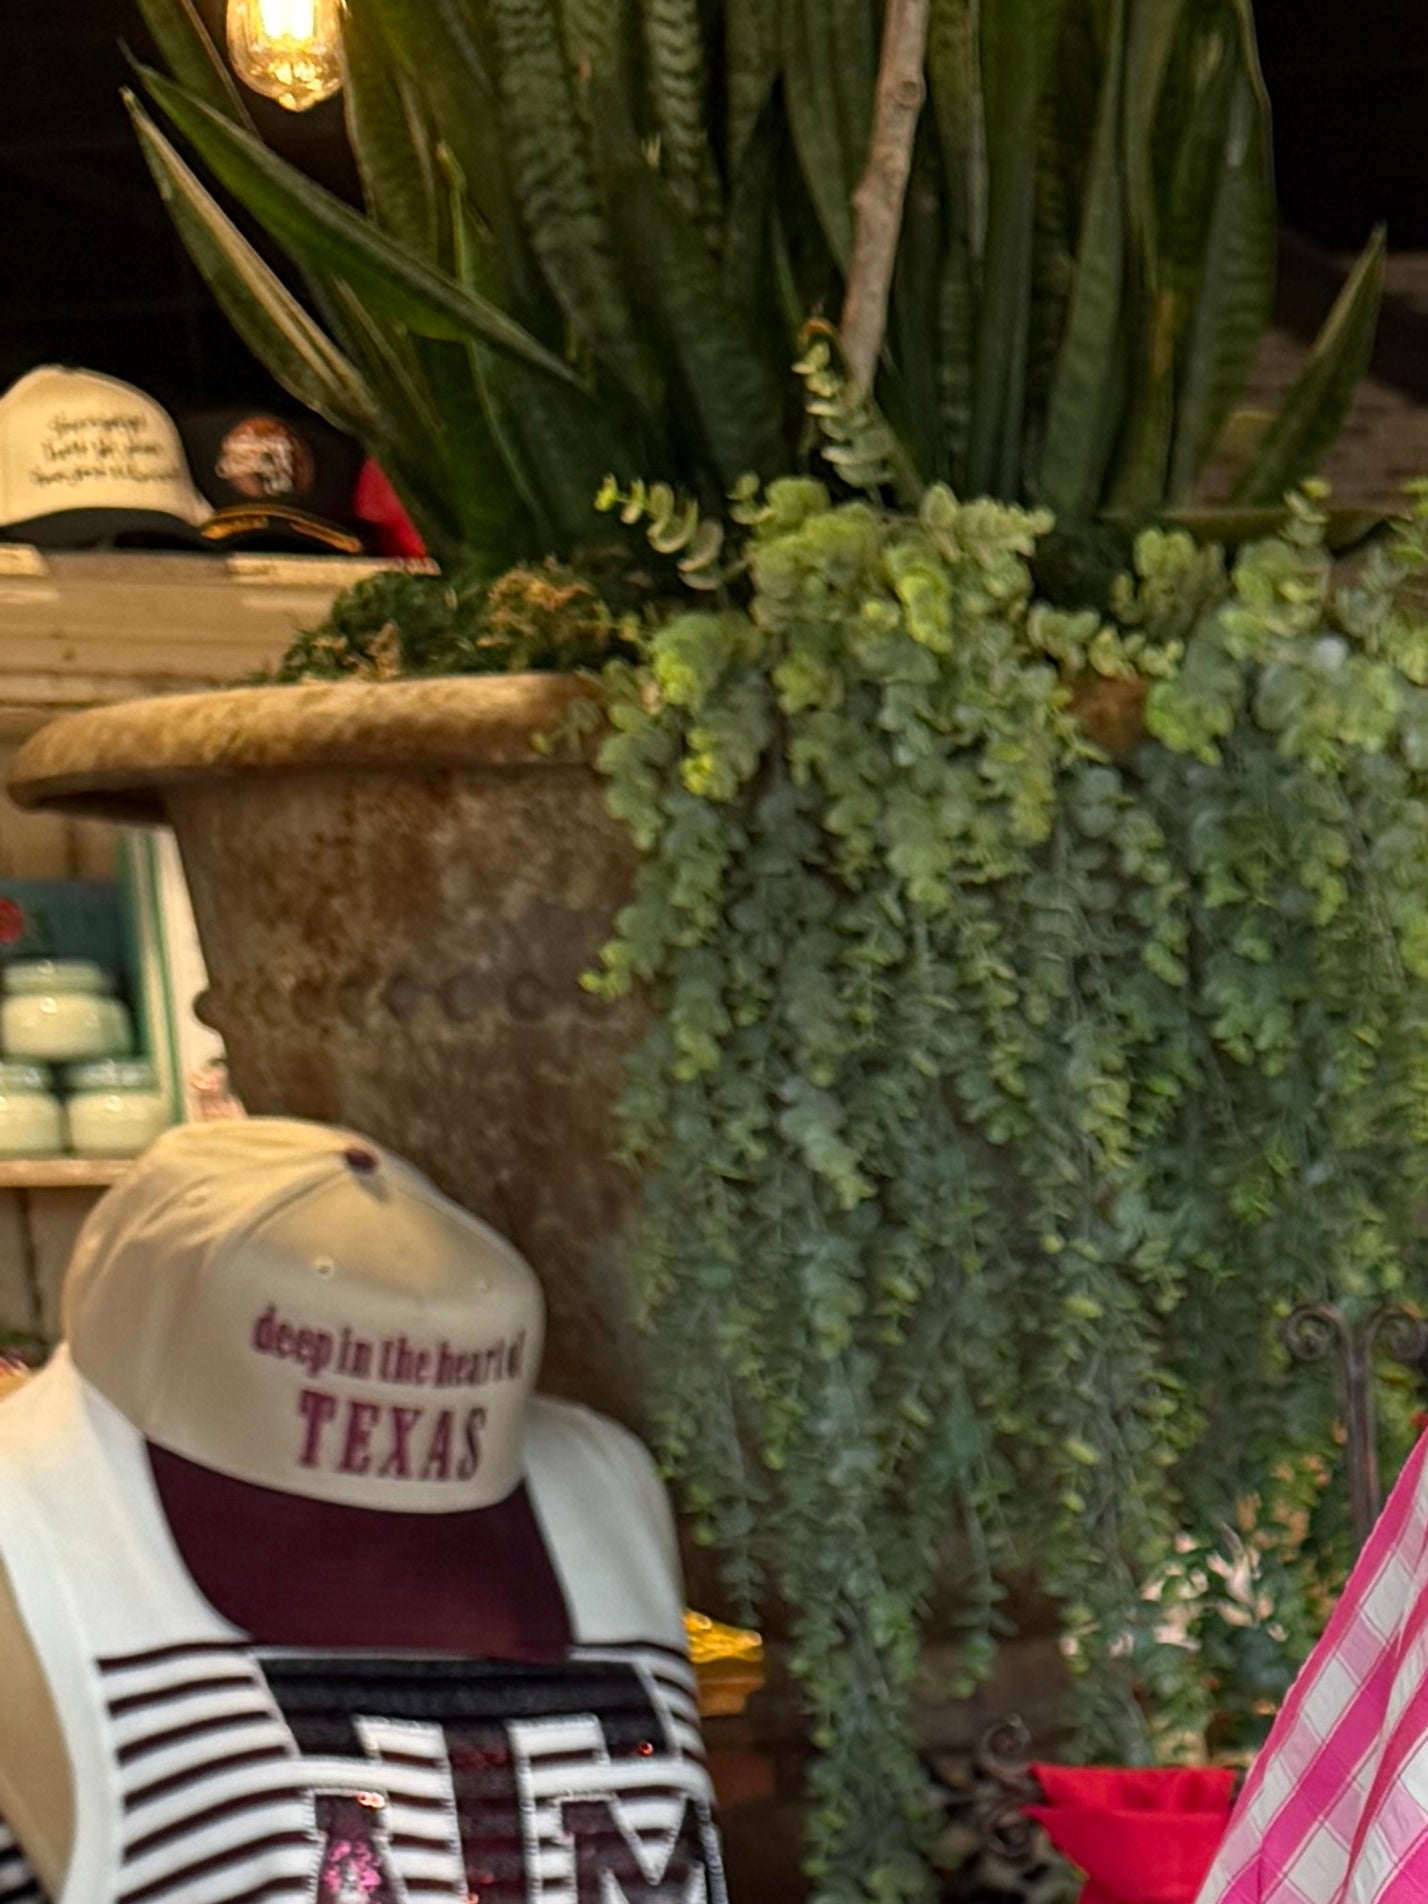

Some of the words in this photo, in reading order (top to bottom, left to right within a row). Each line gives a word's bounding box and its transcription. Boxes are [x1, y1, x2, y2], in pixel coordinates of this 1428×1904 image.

[253, 1303, 333, 1379] deep
[336, 1326, 374, 1379] in
[379, 1331, 430, 1387] the
[431, 1339, 505, 1389] heart
[296, 1388, 488, 1483] TEXAS
